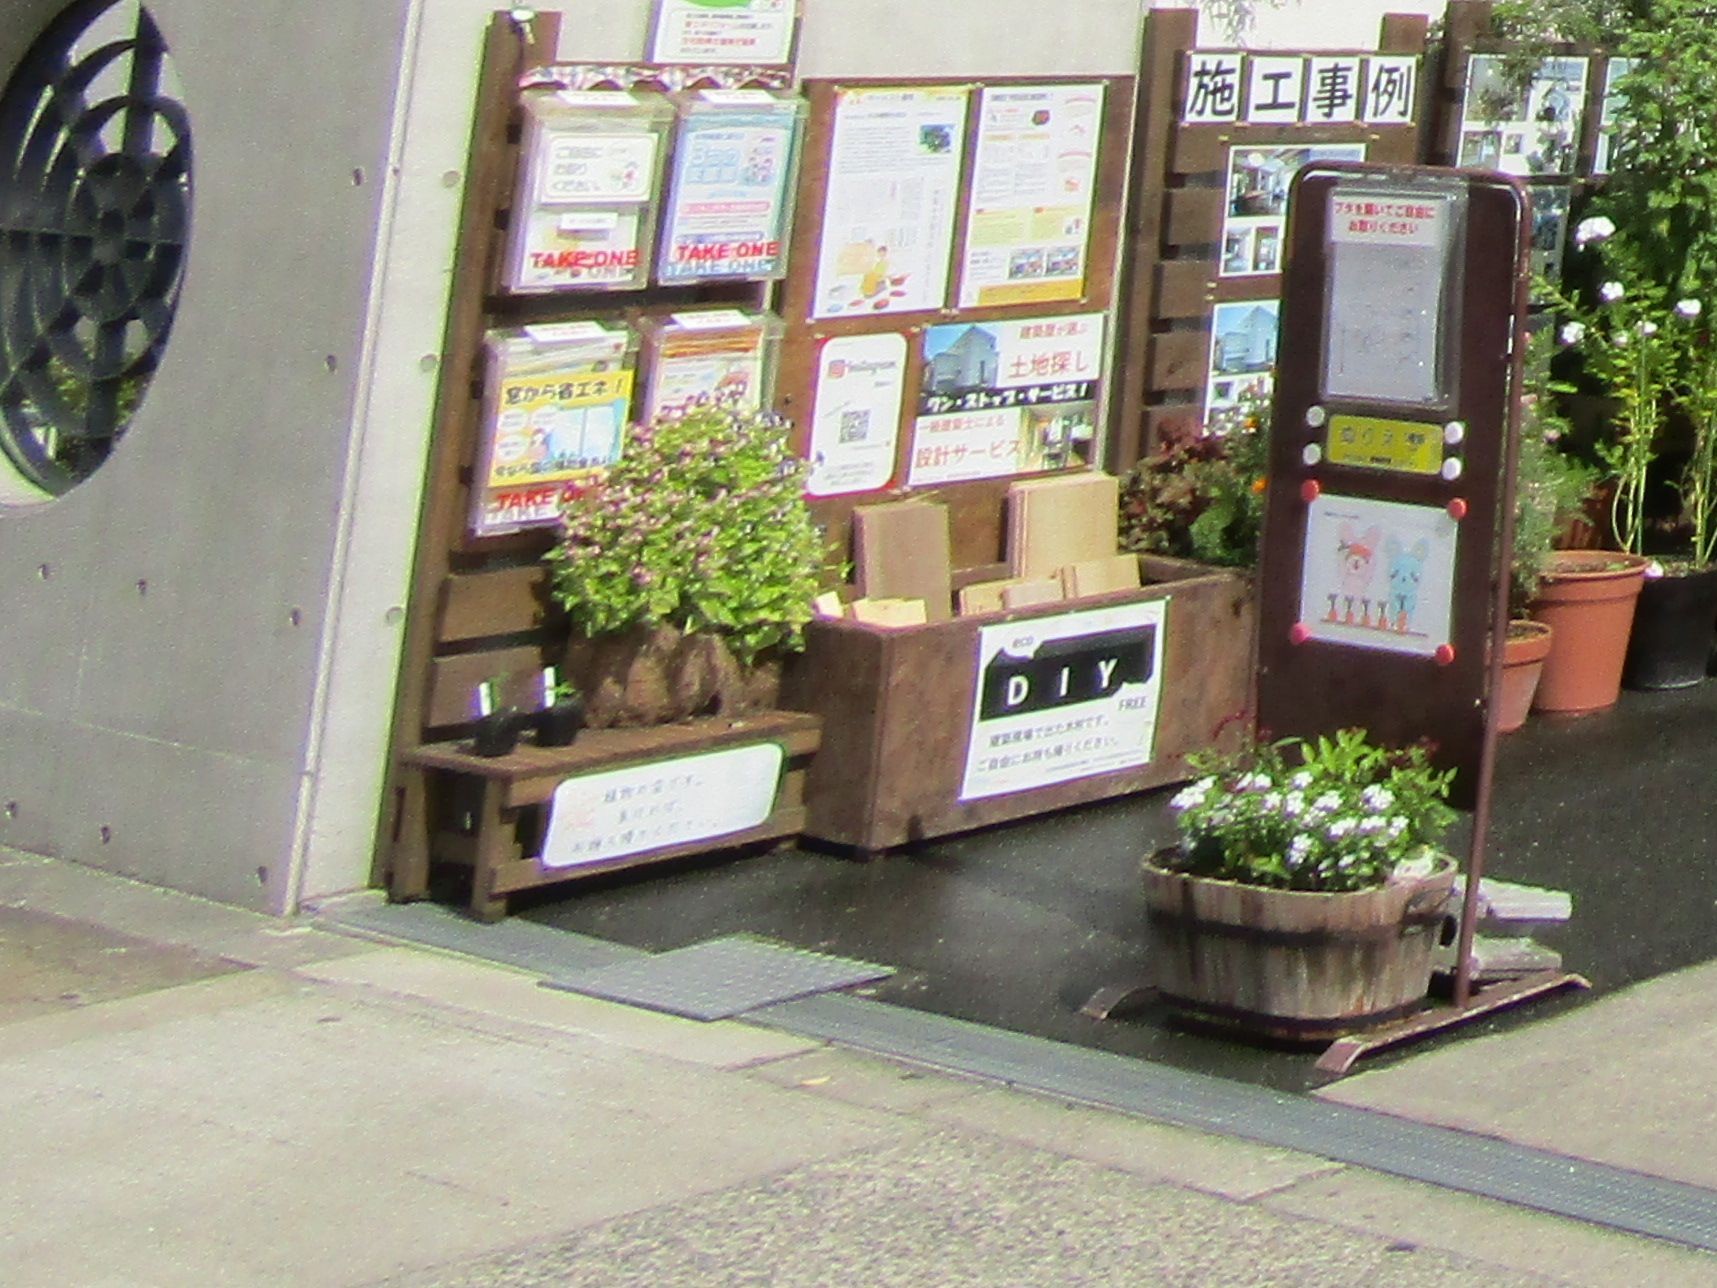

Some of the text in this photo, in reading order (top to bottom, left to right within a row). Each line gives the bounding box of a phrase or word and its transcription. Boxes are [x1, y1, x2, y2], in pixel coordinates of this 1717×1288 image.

[1186, 58, 1415, 121] 施工事例
[531, 249, 642, 268] TAKE ONE
[677, 240, 783, 261] TAKE ONE
[1008, 349, 1090, 379] 土地探し
[916, 439, 1021, 469] 設計サービス
[1012, 636, 1034, 648] eco
[1118, 696, 1147, 711] FREE
